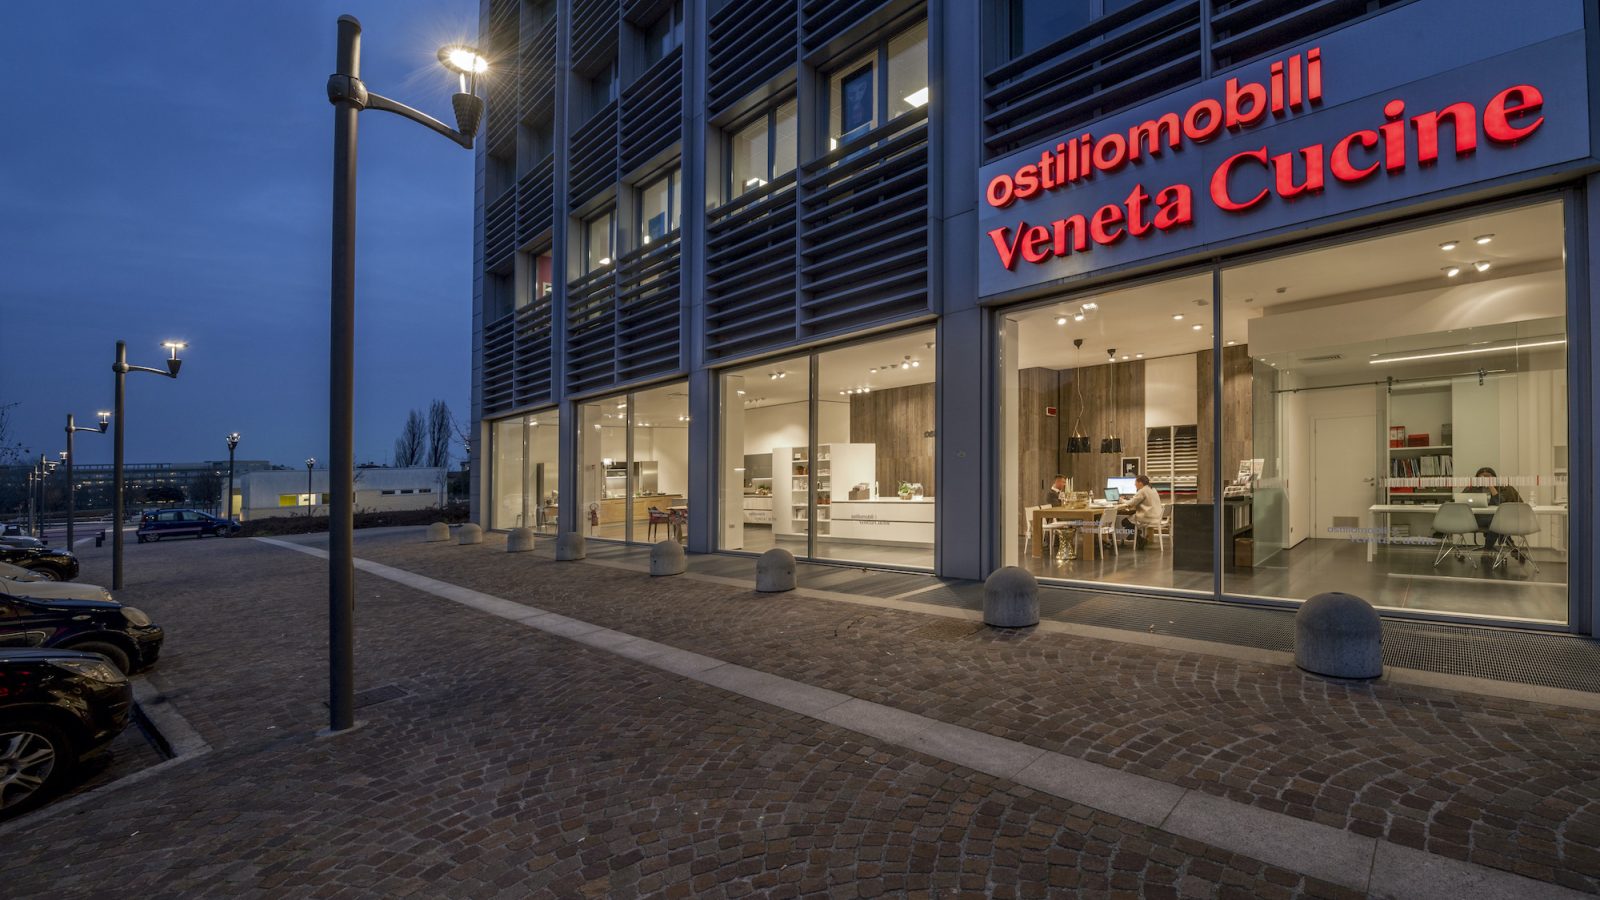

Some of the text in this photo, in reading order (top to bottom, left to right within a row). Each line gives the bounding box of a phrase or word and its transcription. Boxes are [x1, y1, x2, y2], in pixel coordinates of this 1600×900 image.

[985, 47, 1323, 208] ostiliomobili
[986, 84, 1546, 271] Veneta Cucine
